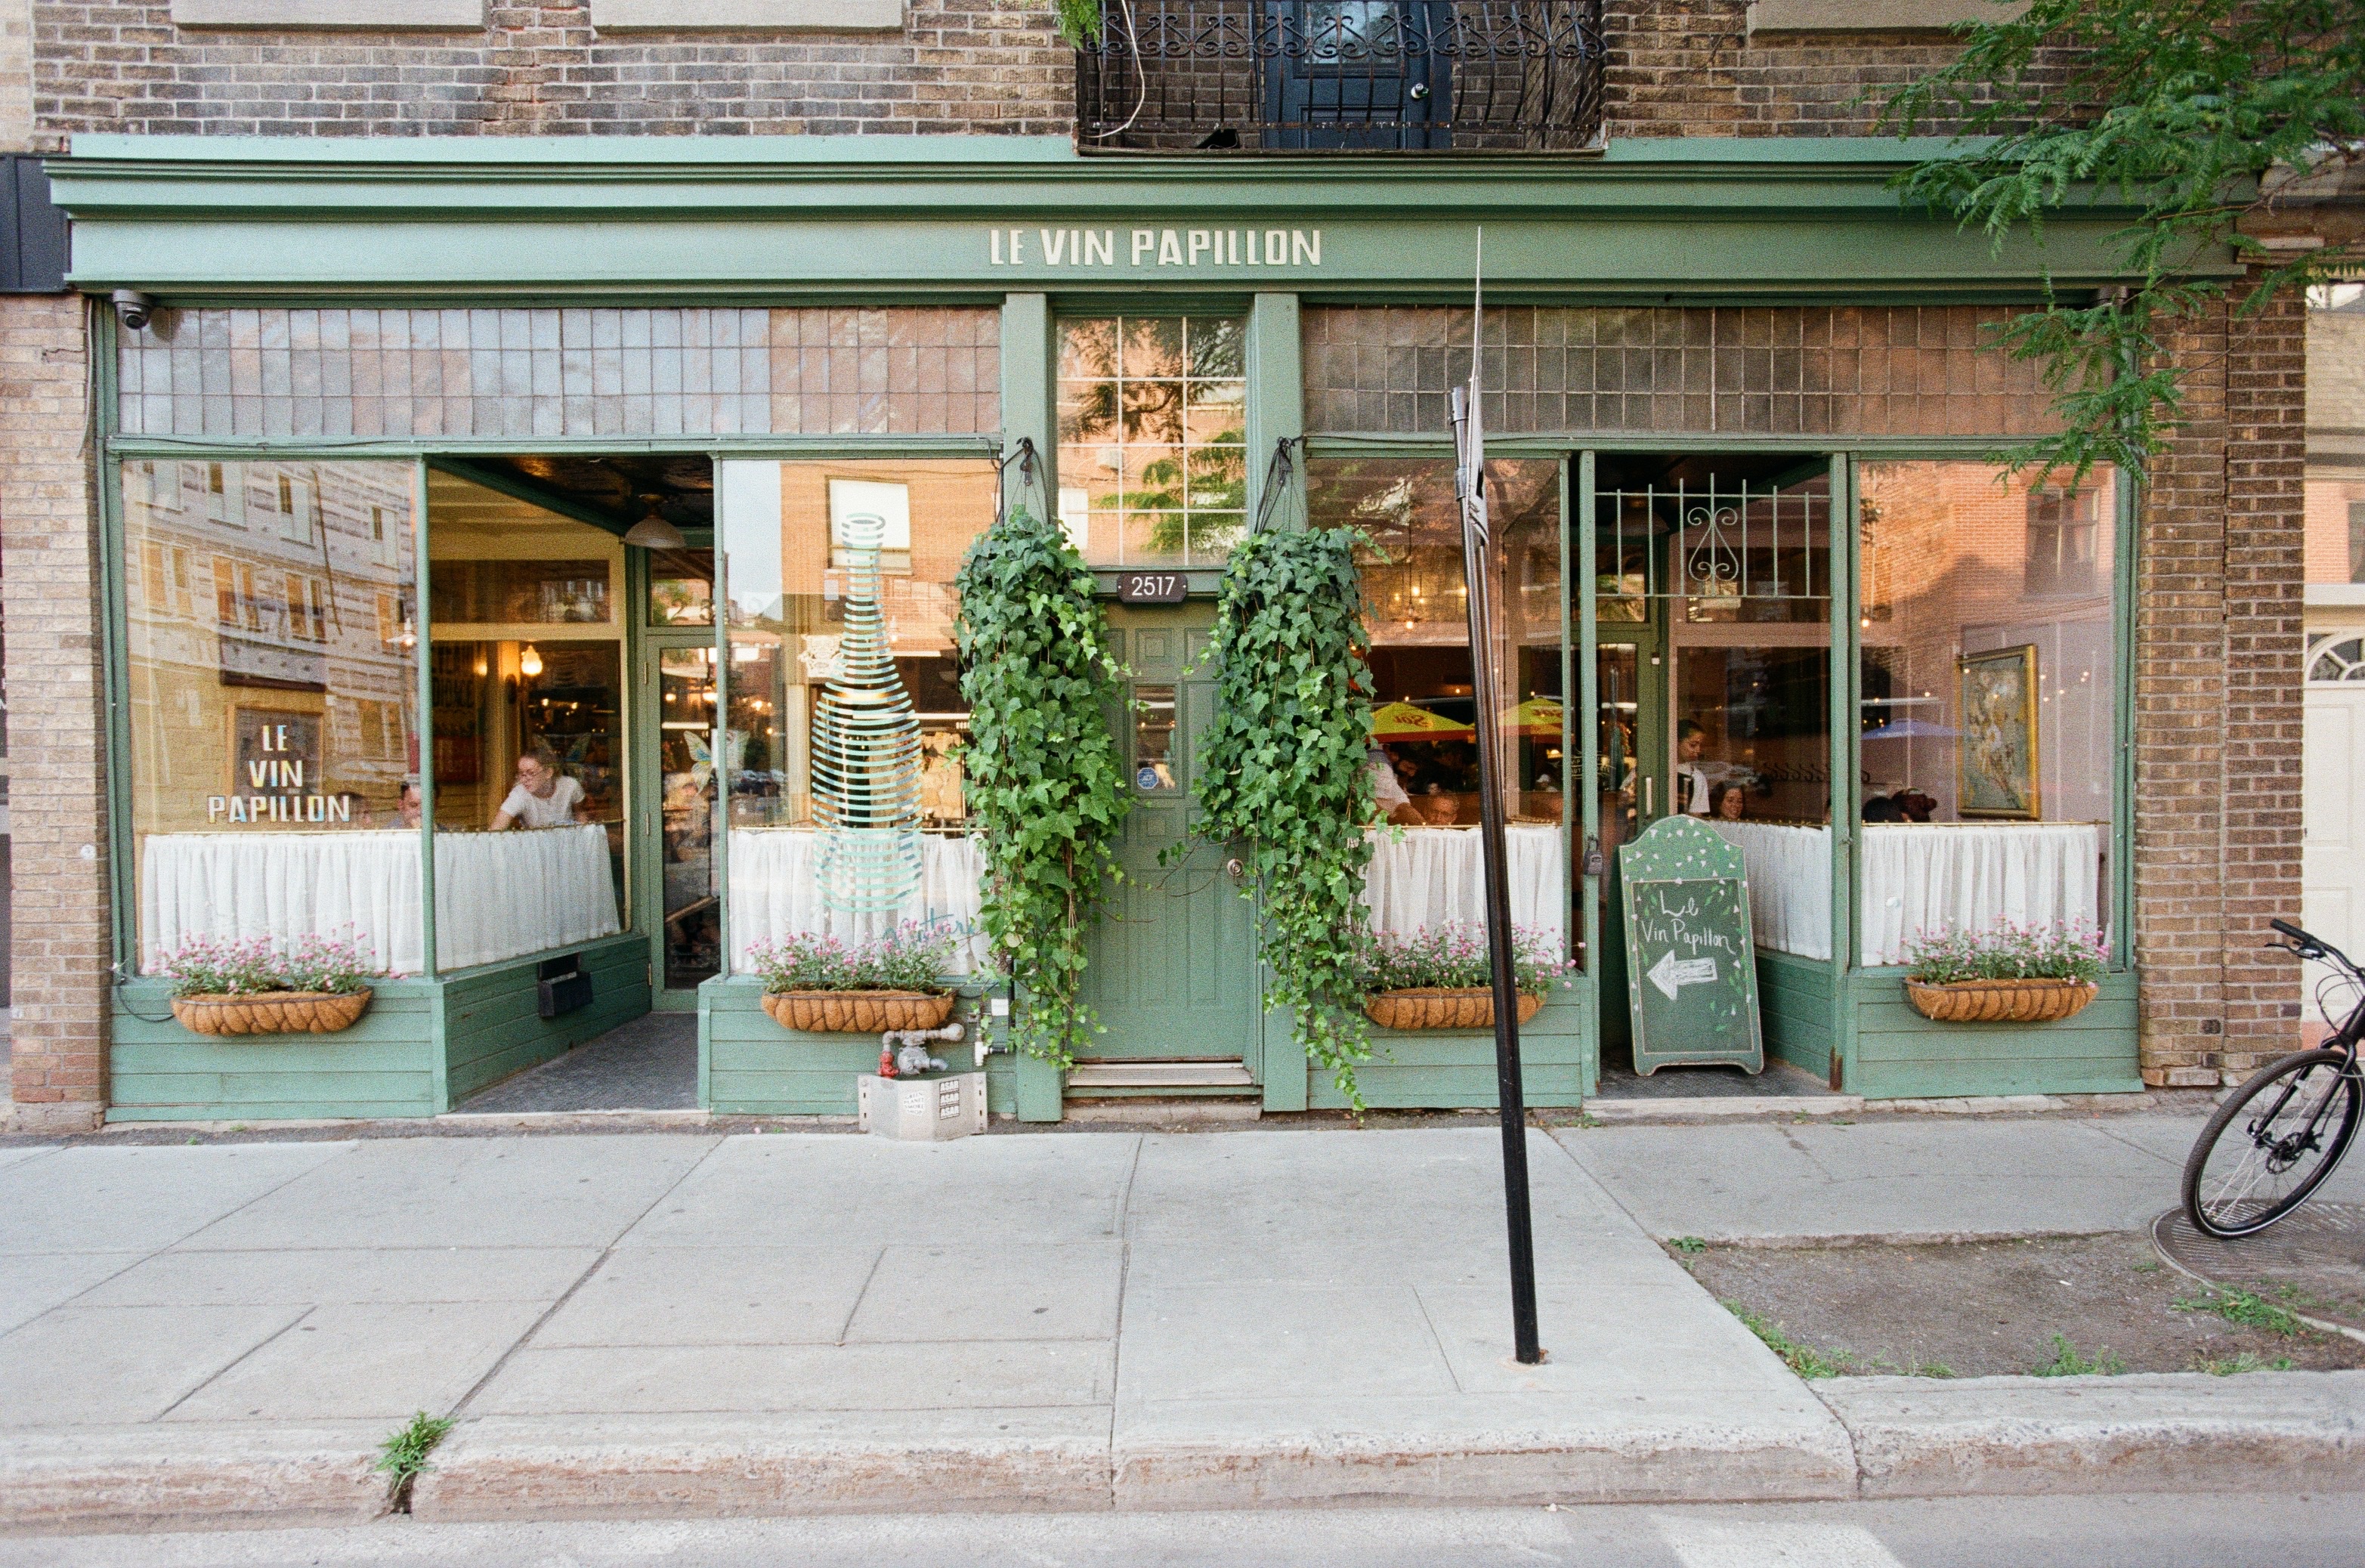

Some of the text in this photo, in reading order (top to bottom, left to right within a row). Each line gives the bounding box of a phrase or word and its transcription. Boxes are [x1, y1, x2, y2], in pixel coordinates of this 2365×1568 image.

[990, 229, 1321, 266] LE VIN PAPILLON
[1131, 576, 1175, 596] 2517
[261, 725, 288, 751] LE
[249, 759, 303, 787] VIN
[207, 795, 351, 824] PAPILLON
[1659, 889, 1699, 917] Le
[1641, 918, 1736, 955] Vin Papillon
